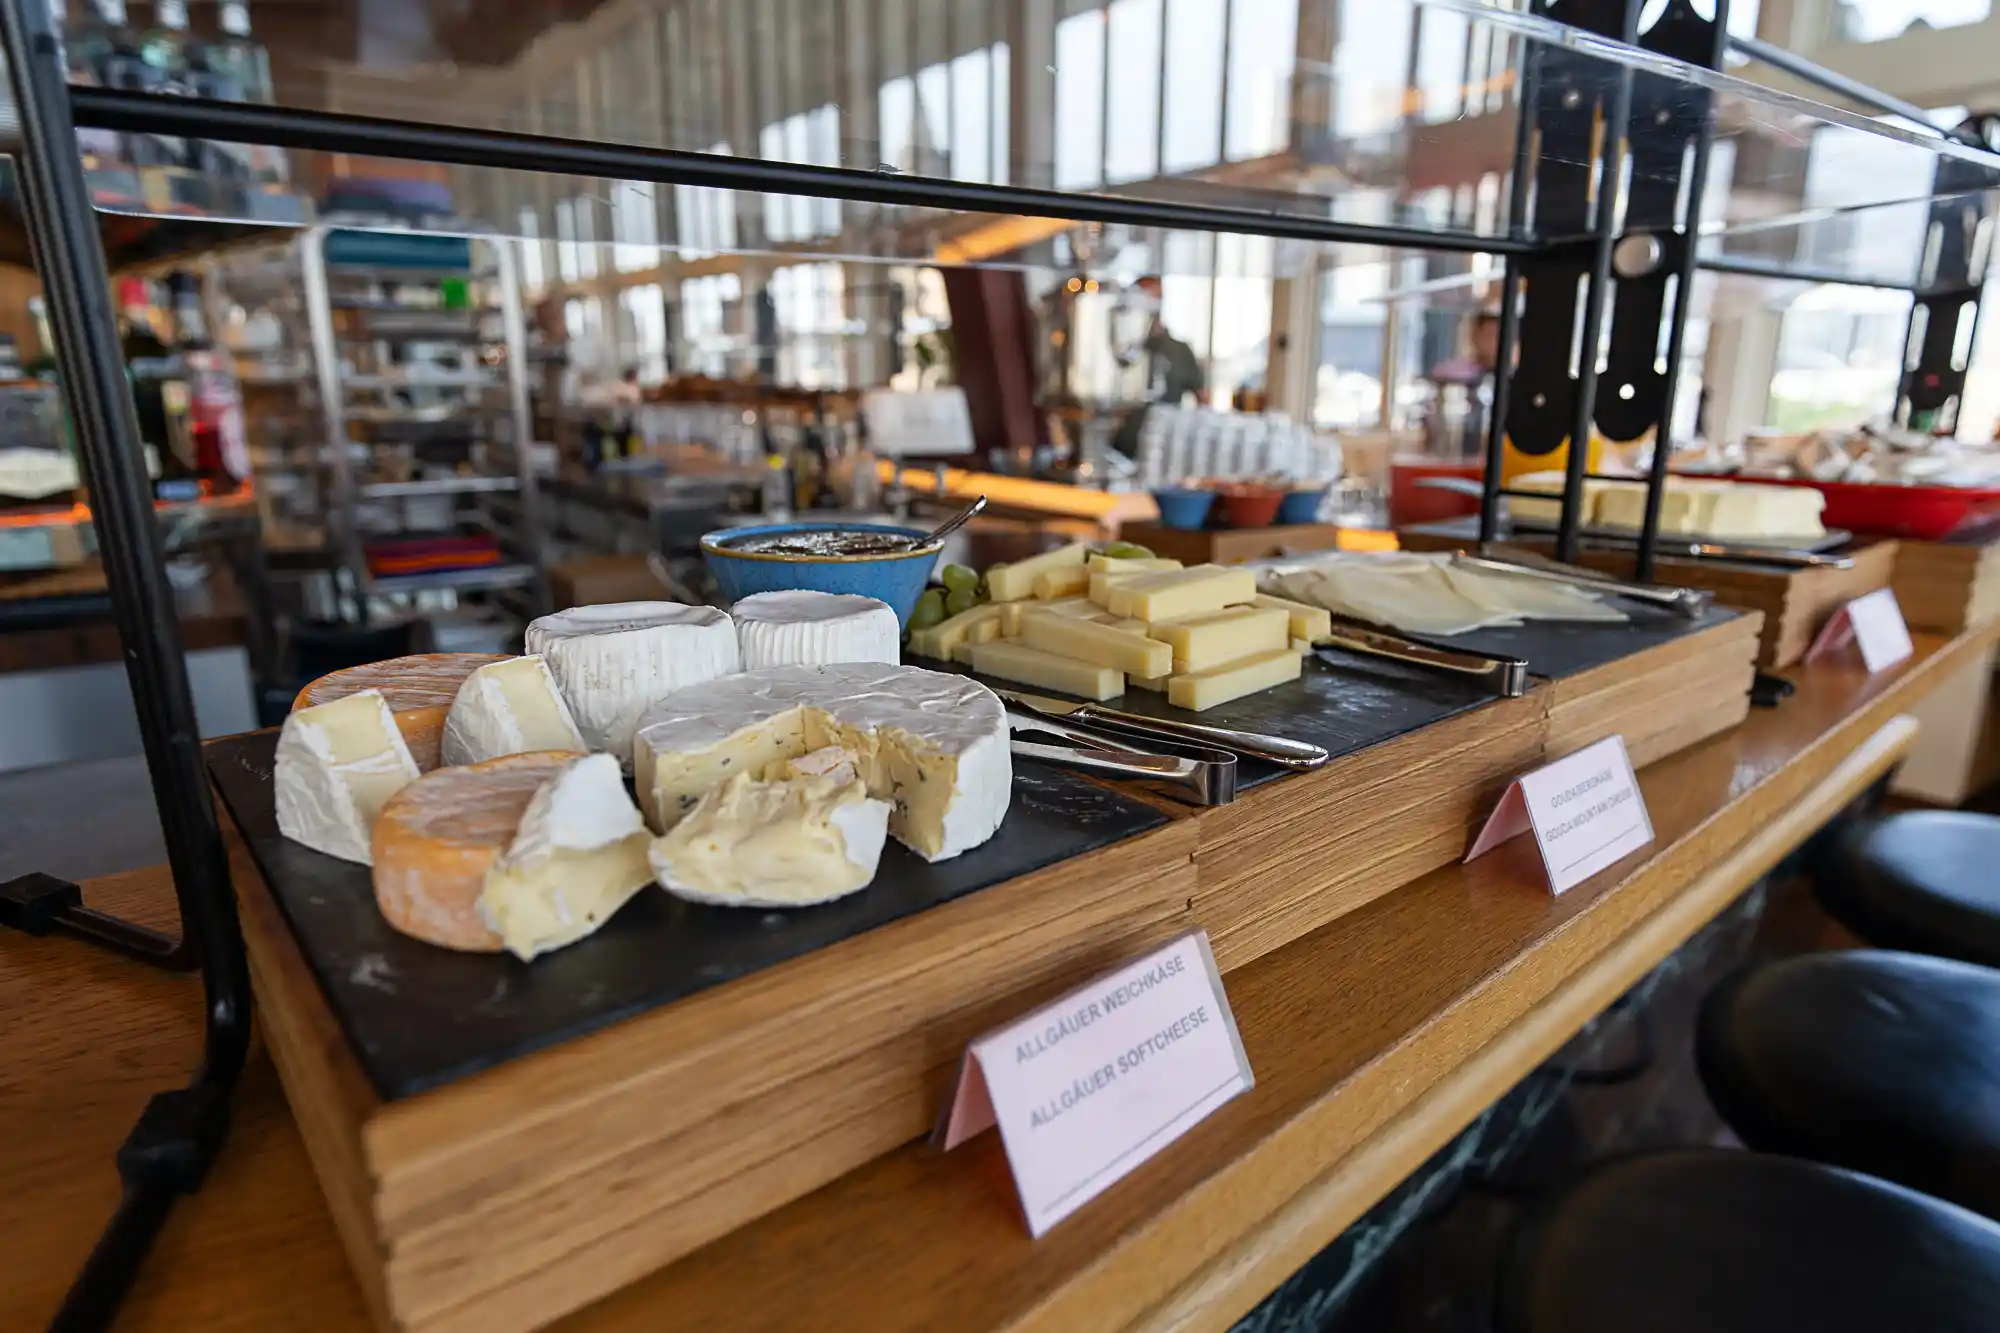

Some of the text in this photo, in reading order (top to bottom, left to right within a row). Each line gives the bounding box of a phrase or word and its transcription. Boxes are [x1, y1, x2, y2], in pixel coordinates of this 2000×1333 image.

[1545, 820, 1574, 842] GOUDA
[1016, 955, 1185, 1064] ALLGÄUER WEICHKÄSE
[1030, 1005, 1209, 1129] ALLGÄUER SOFTCHEESE
